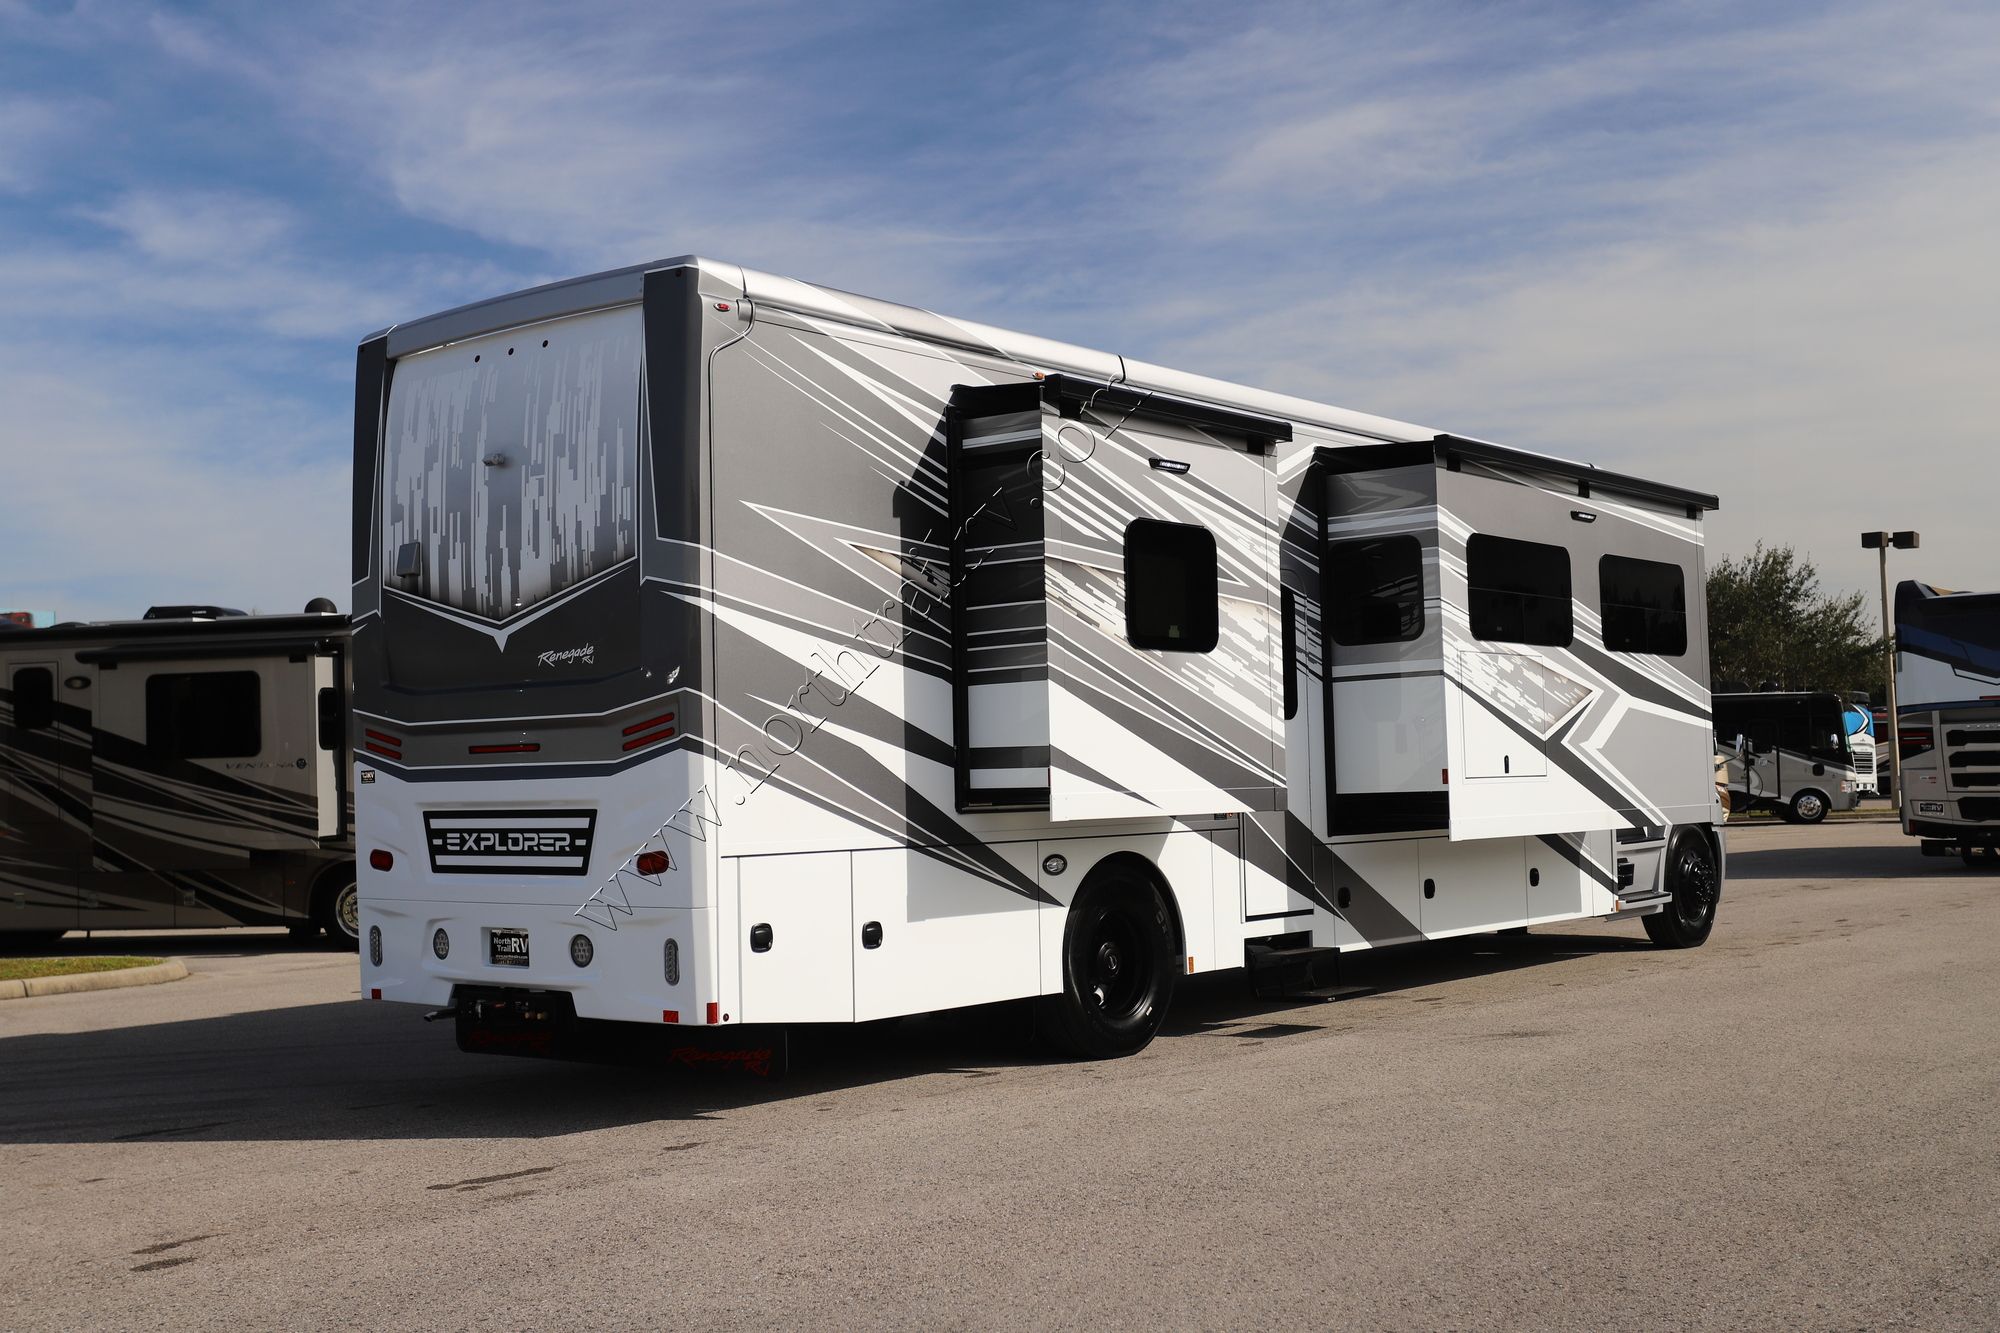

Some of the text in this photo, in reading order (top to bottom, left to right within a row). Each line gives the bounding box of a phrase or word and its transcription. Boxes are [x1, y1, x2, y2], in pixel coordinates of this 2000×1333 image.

[537, 642, 594, 667] Renegade
[446, 832, 571, 852] EXPLORER
[493, 937, 511, 945] North
[496, 944, 511, 952] Trail
[511, 937, 529, 953] RV
